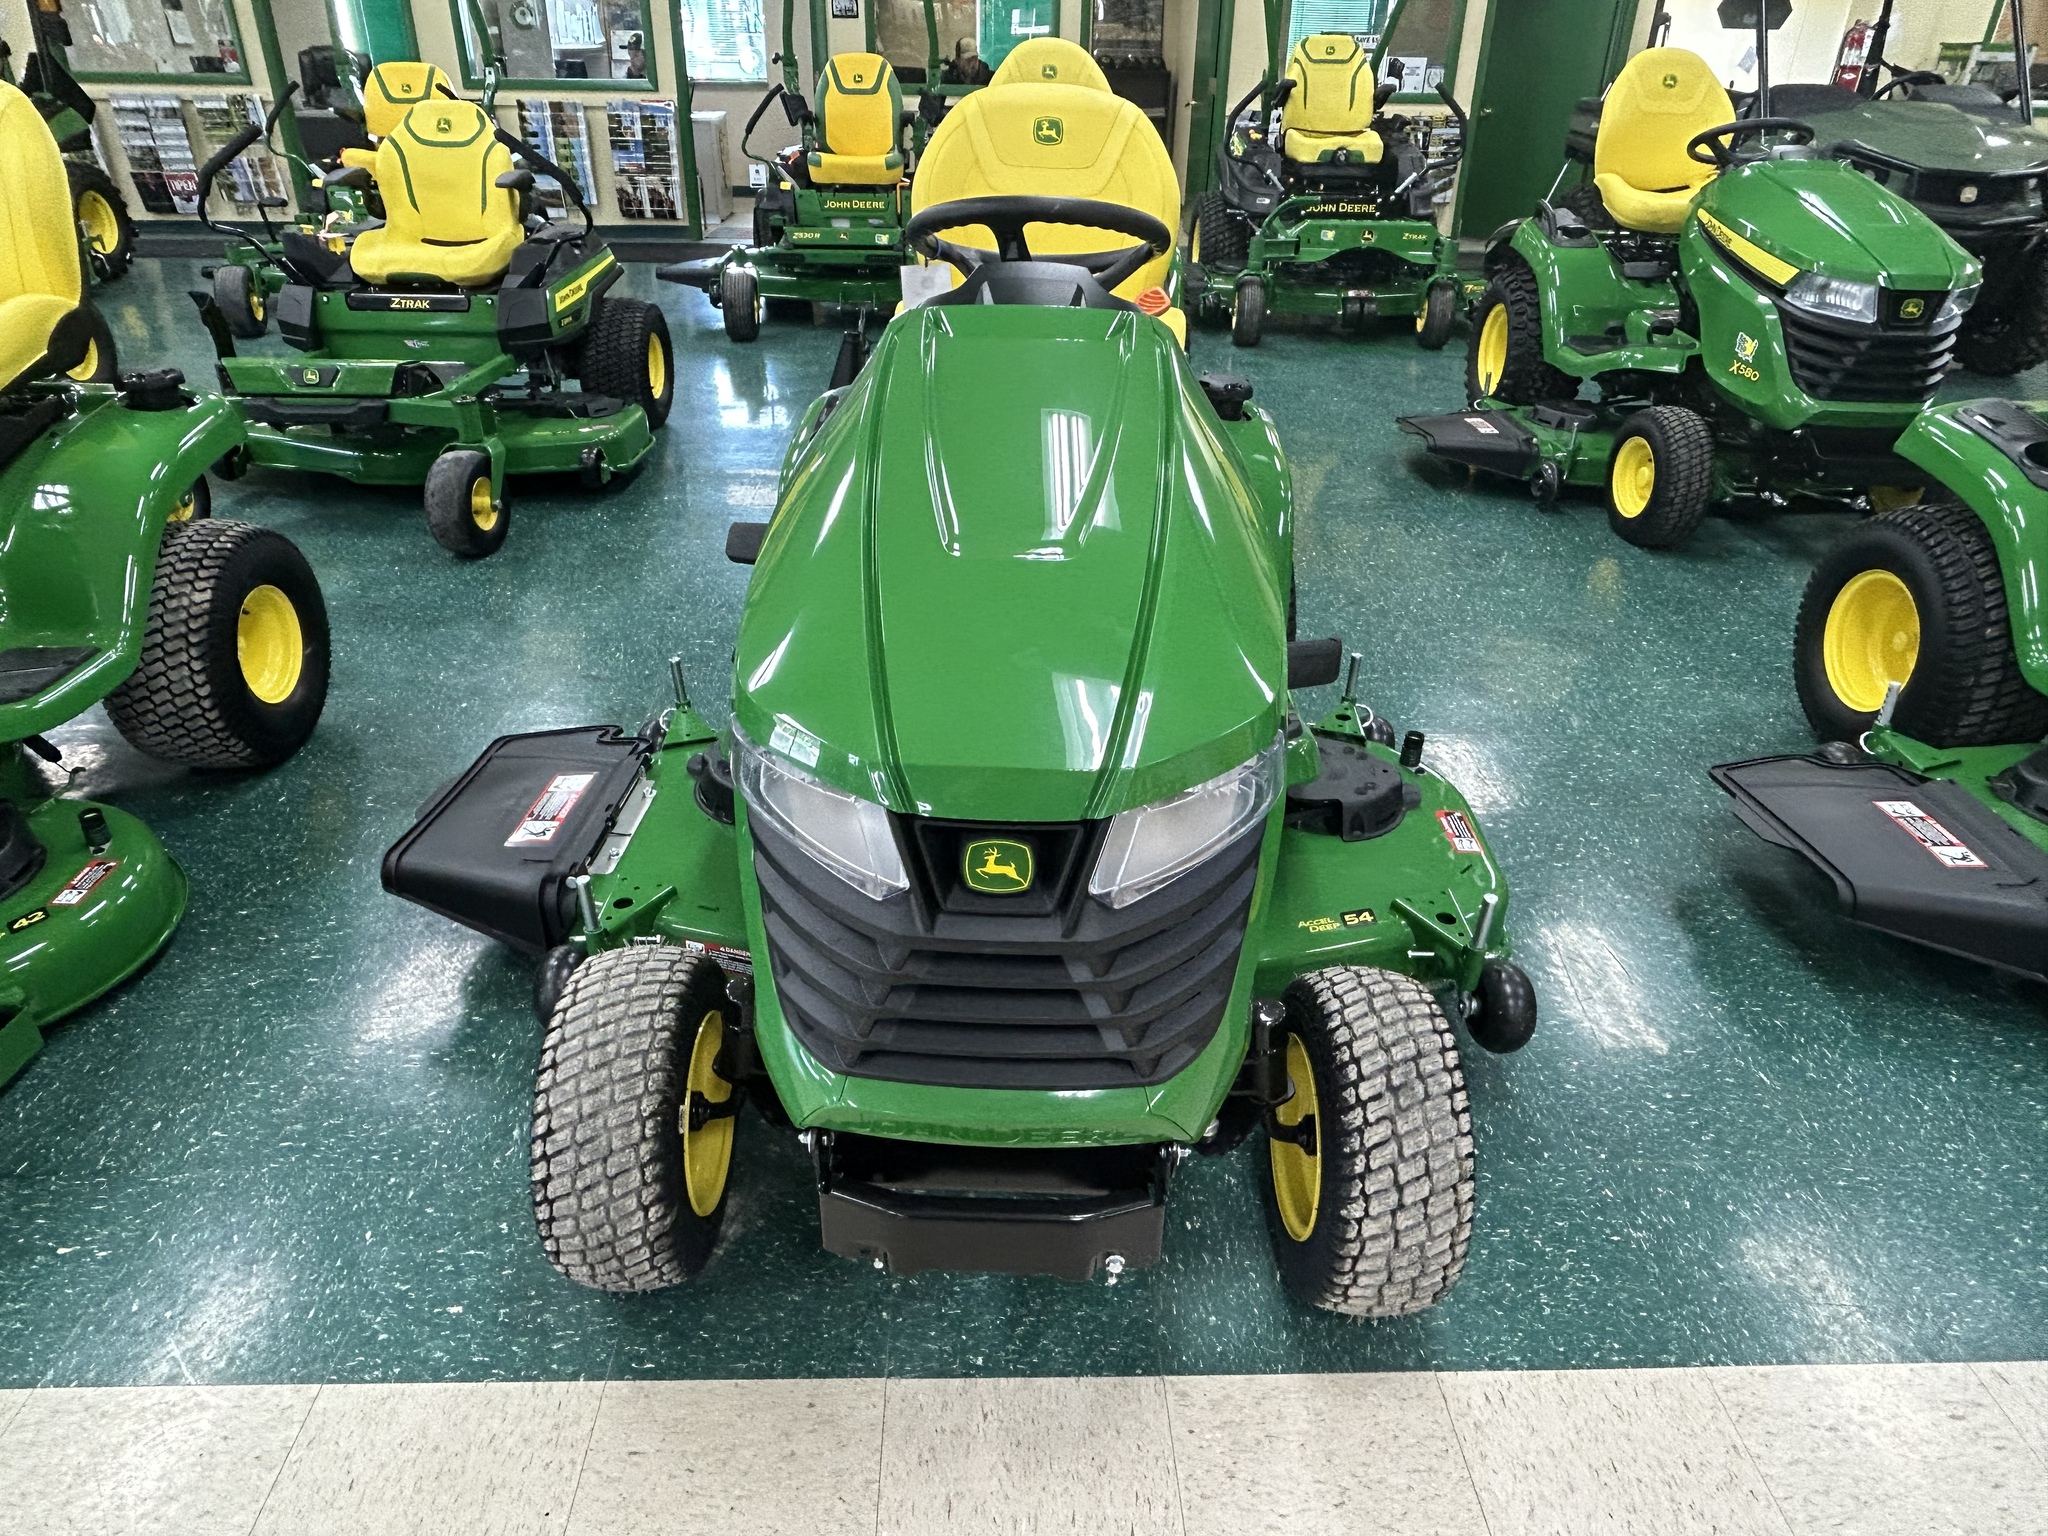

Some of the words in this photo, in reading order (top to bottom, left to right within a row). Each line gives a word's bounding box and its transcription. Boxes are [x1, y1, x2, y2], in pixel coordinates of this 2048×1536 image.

[824, 200, 850, 208] JOHN
[852, 200, 885, 209] DEERE
[1339, 202, 1377, 213] DEERE
[390, 297, 430, 309] ZTRAK
[1728, 359, 1760, 381] X580
[12, 911, 46, 929] 42
[1298, 917, 1335, 928] ACCEL
[1343, 911, 1374, 925] 54
[1308, 922, 1341, 933] DEEP
